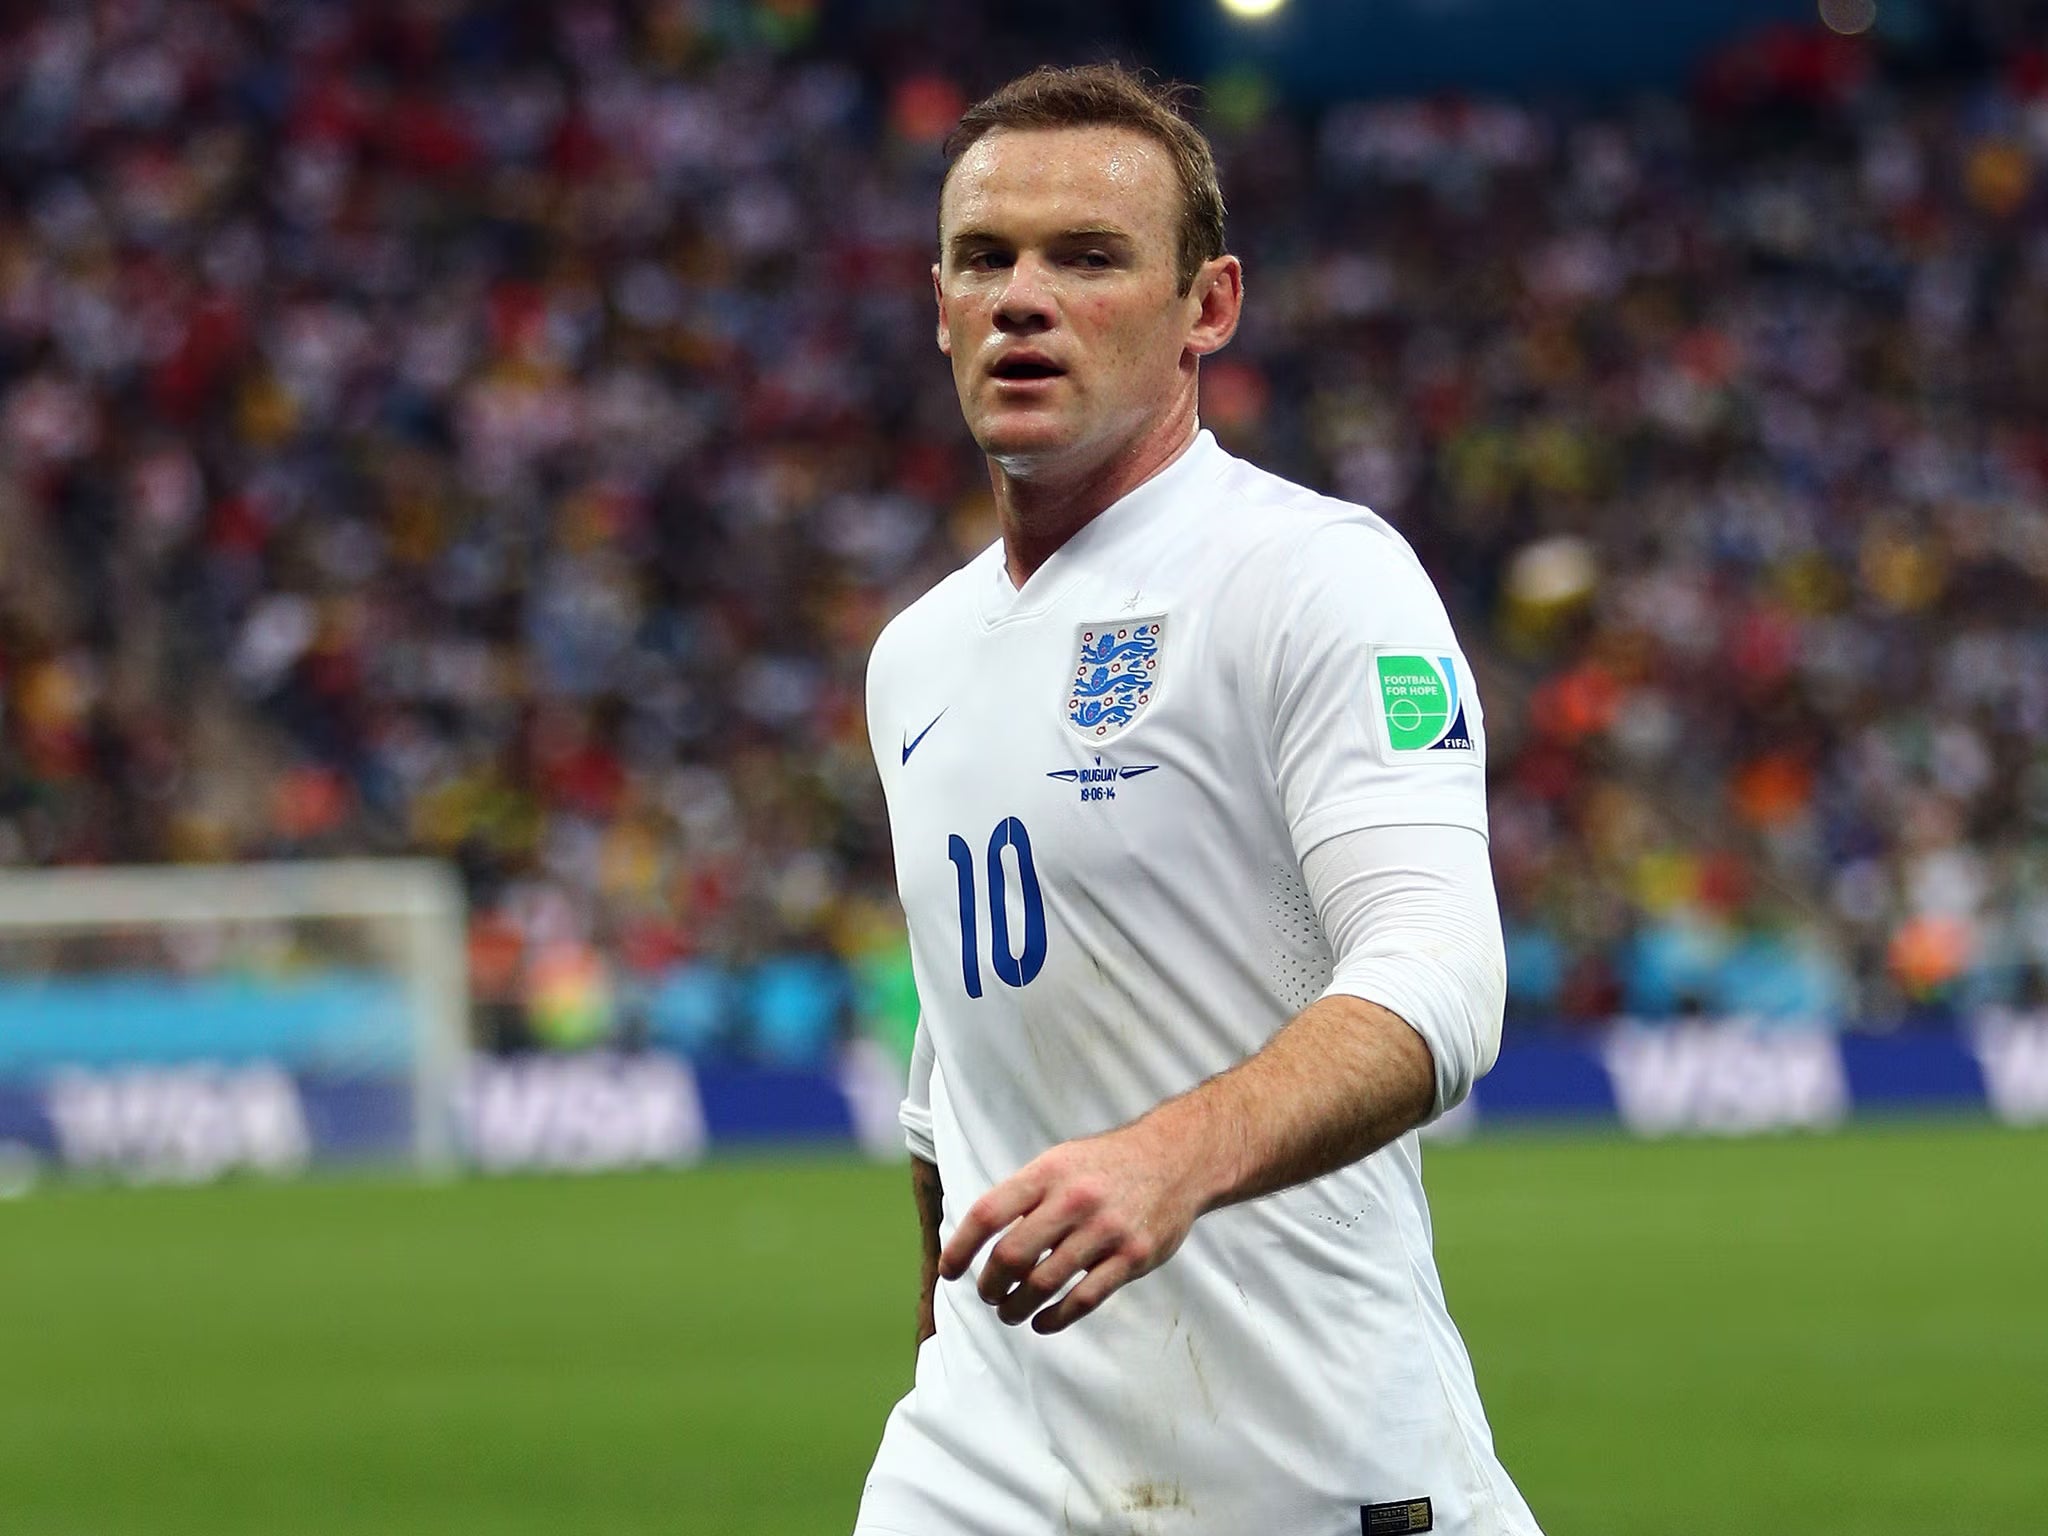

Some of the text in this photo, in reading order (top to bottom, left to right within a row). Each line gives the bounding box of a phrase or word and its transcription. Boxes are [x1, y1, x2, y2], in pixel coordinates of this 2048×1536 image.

[1383, 675, 1438, 685] FOOTBALL
[1386, 686, 1438, 695] FOR HOPE
[1444, 738, 1469, 749] FIFA
[1079, 768, 1118, 783] URUGUAY
[949, 816, 1047, 999] 10
